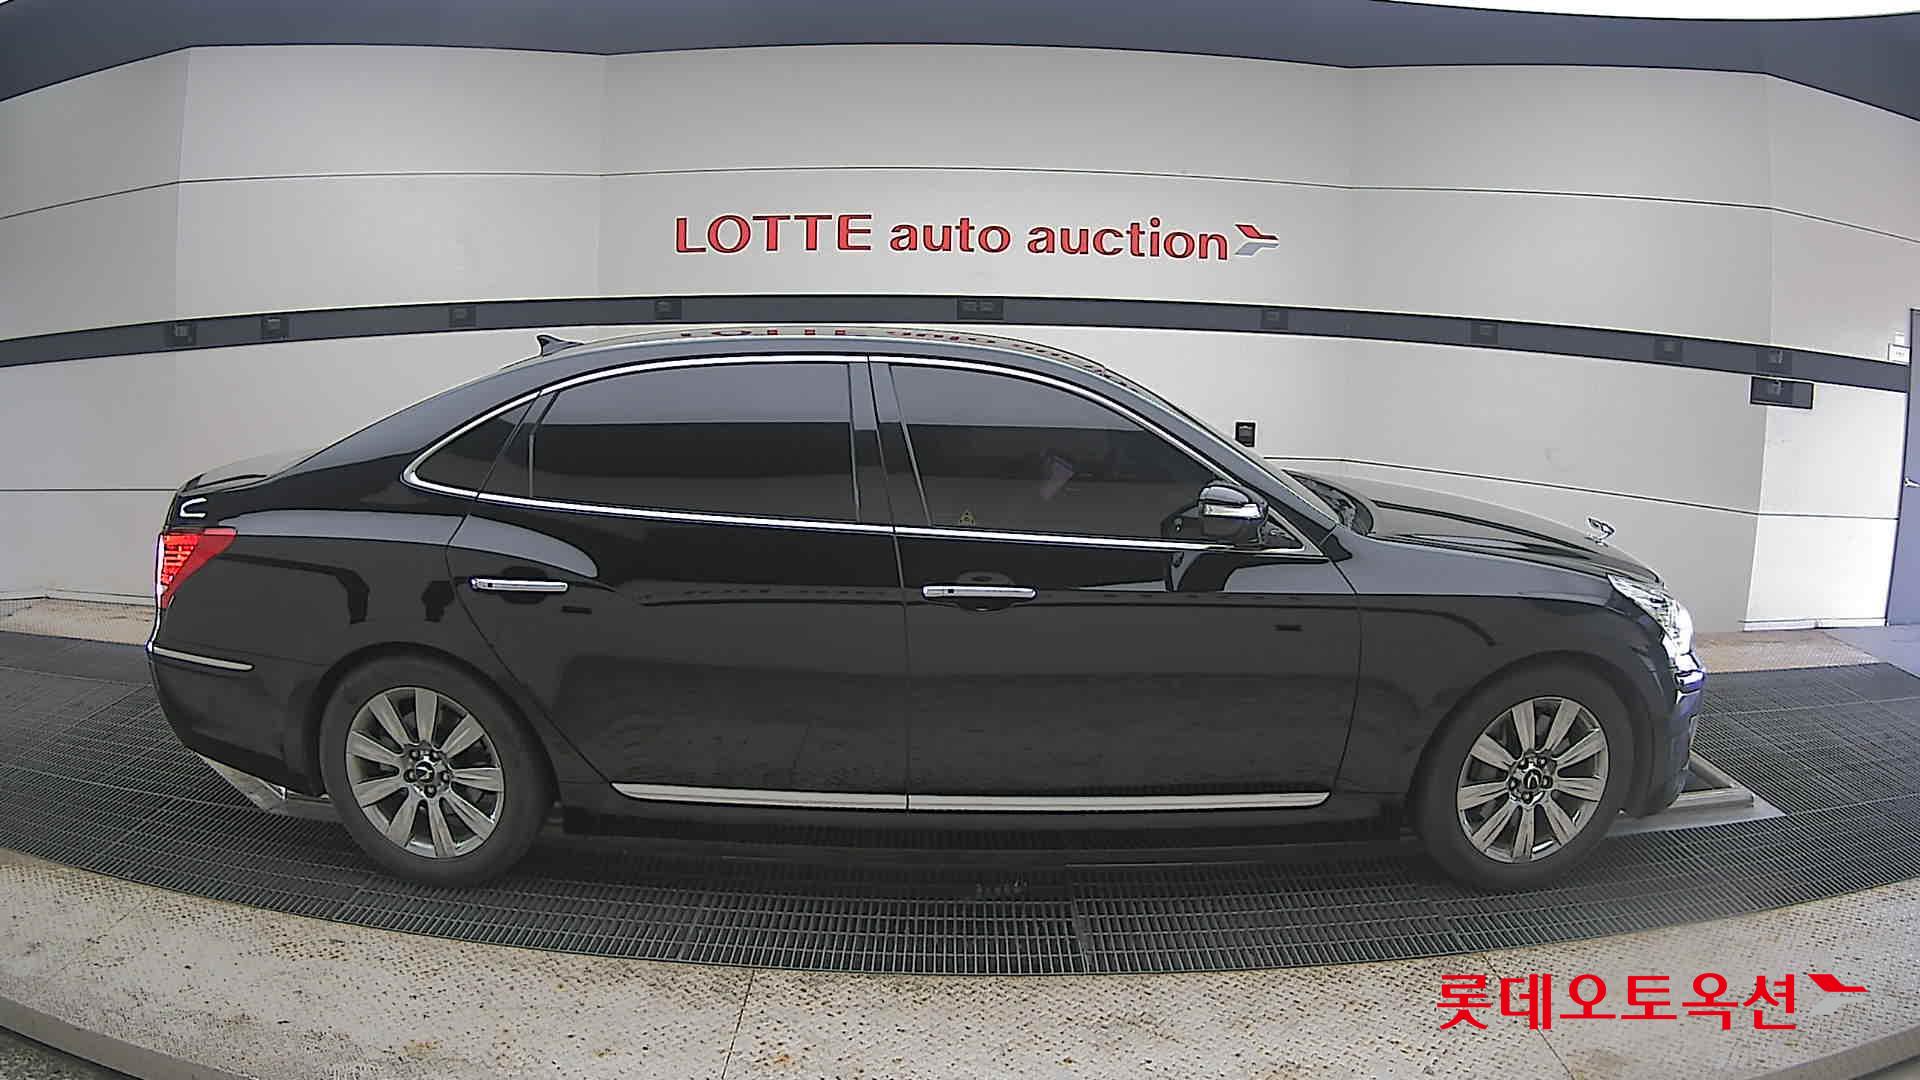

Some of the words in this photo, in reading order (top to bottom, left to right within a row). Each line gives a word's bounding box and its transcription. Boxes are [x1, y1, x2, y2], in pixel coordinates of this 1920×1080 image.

[676, 214, 873, 253] LOTTE
[889, 217, 1012, 253] auto
[1028, 217, 1228, 261] auction
